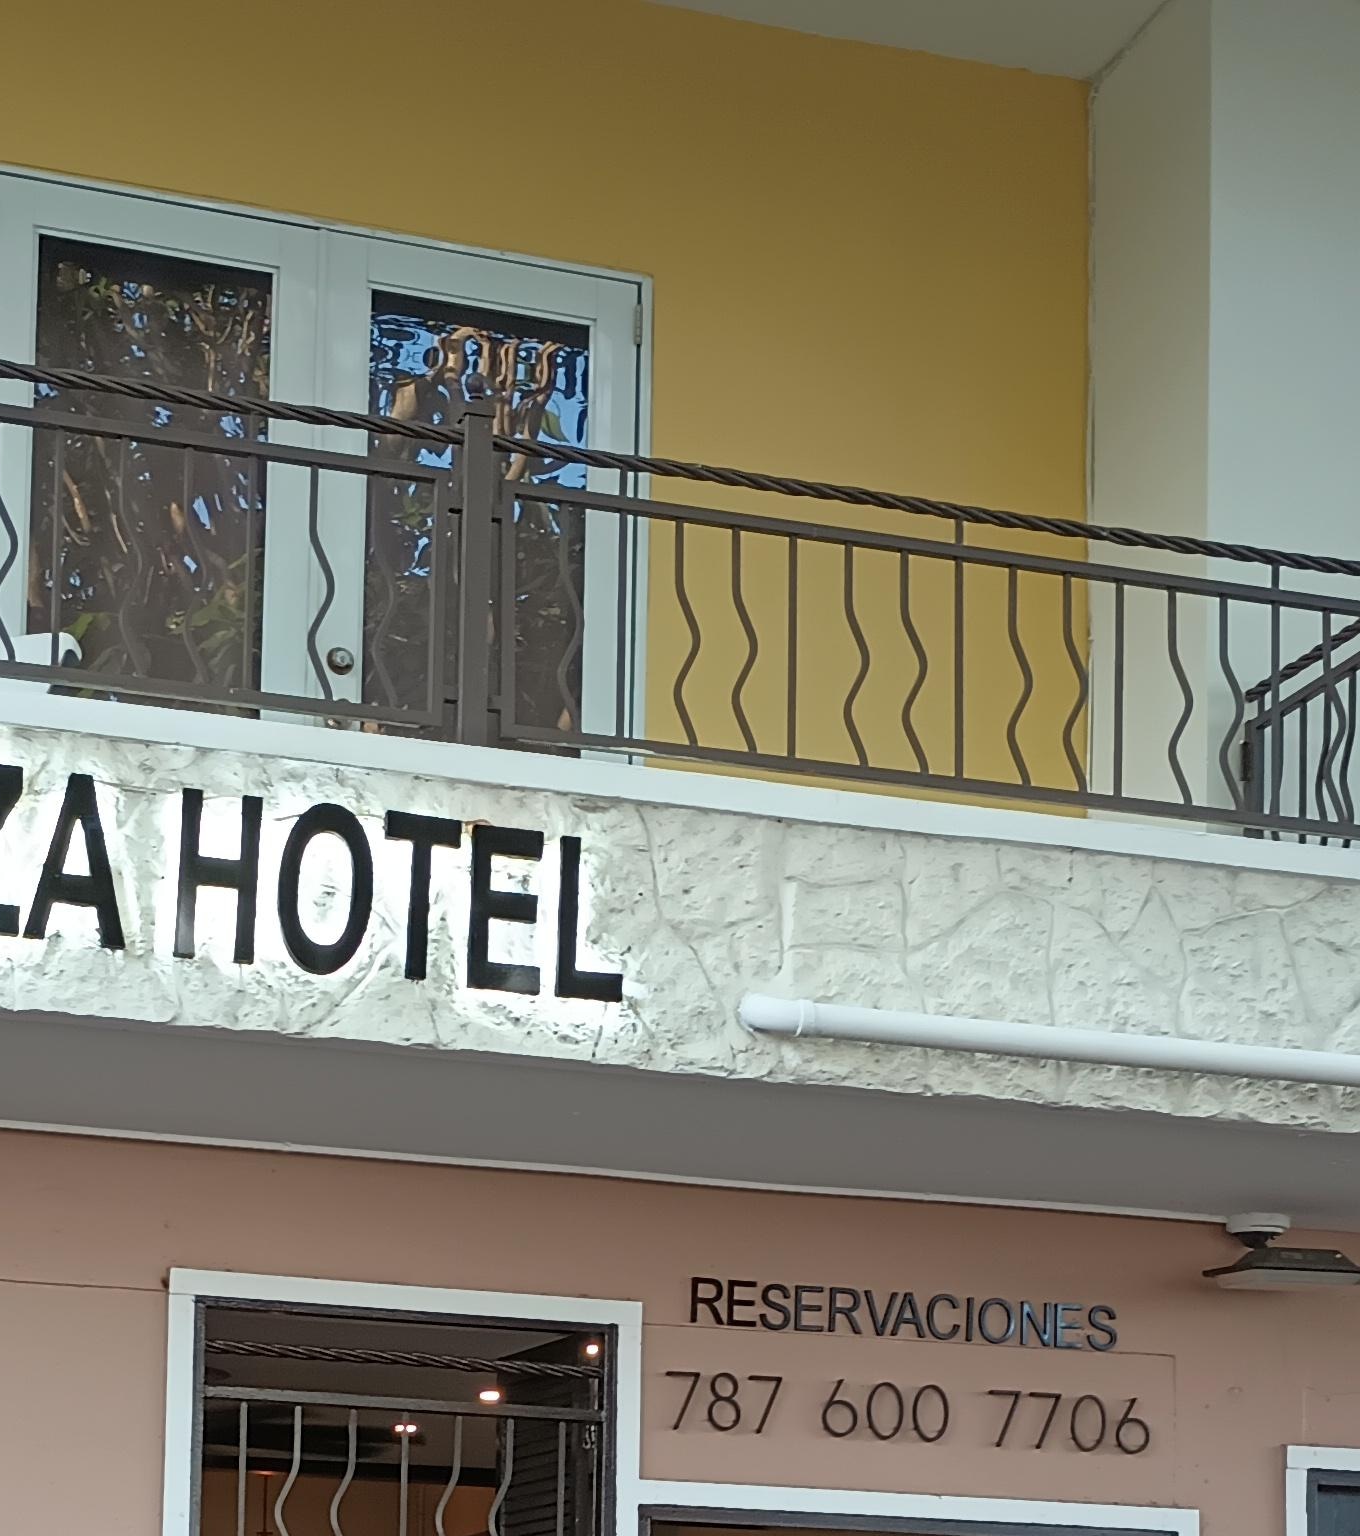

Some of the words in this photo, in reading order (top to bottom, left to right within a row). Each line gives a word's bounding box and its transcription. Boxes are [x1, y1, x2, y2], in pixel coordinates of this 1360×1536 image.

[172, 786, 623, 1003] HOTEL
[689, 1276, 1118, 1353] RESERVACIONES
[665, 1370, 783, 1436] 787
[821, 1378, 950, 1444] 600
[987, 1388, 1151, 1456] 7706
